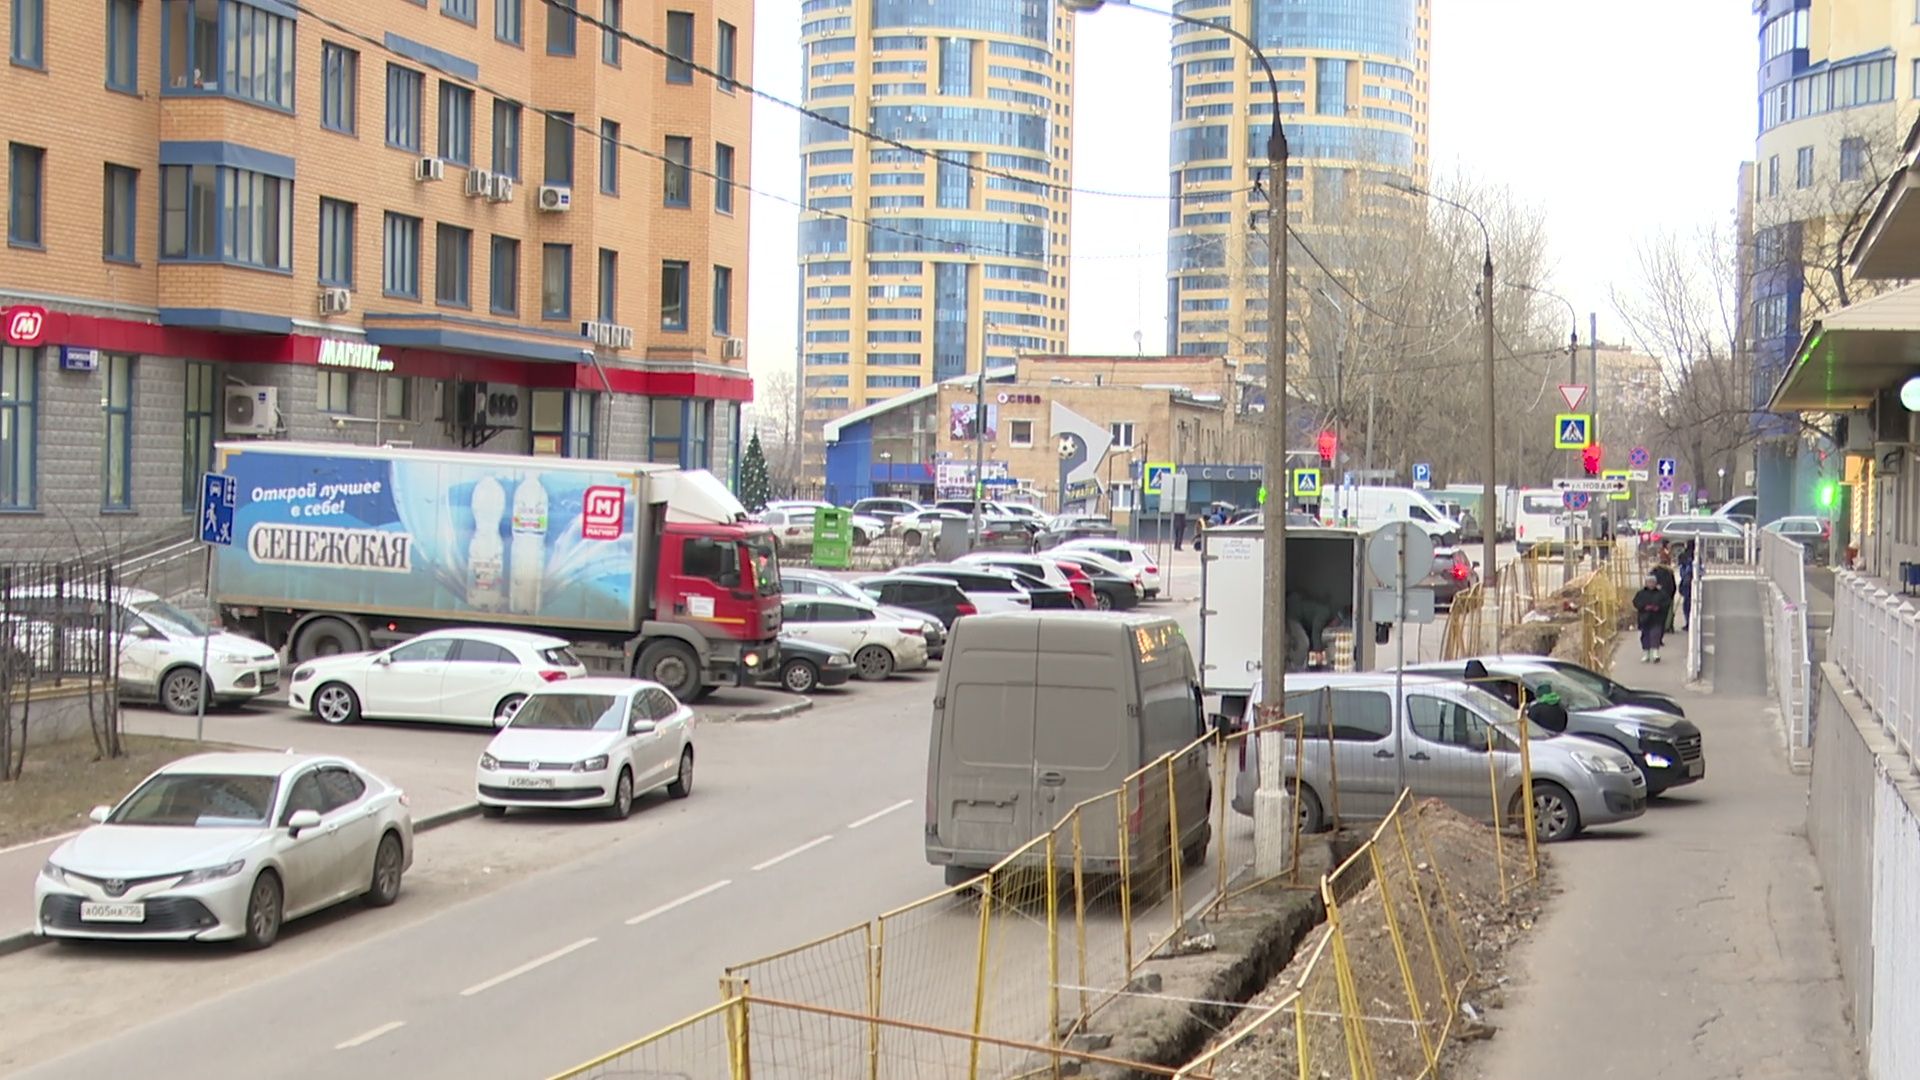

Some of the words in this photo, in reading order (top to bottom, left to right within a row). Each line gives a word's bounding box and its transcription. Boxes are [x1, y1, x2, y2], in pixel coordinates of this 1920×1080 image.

[318, 337, 380, 370] МАГНИТ
[251, 483, 316, 503] Открой
[319, 482, 381, 500] лучшее
[1583, 481, 1612, 490] НОВАЯ
[304, 500, 345, 517] себе!
[586, 526, 618, 537] МАГНИТ
[253, 527, 409, 569] СЕНЕЖСКАЯ
